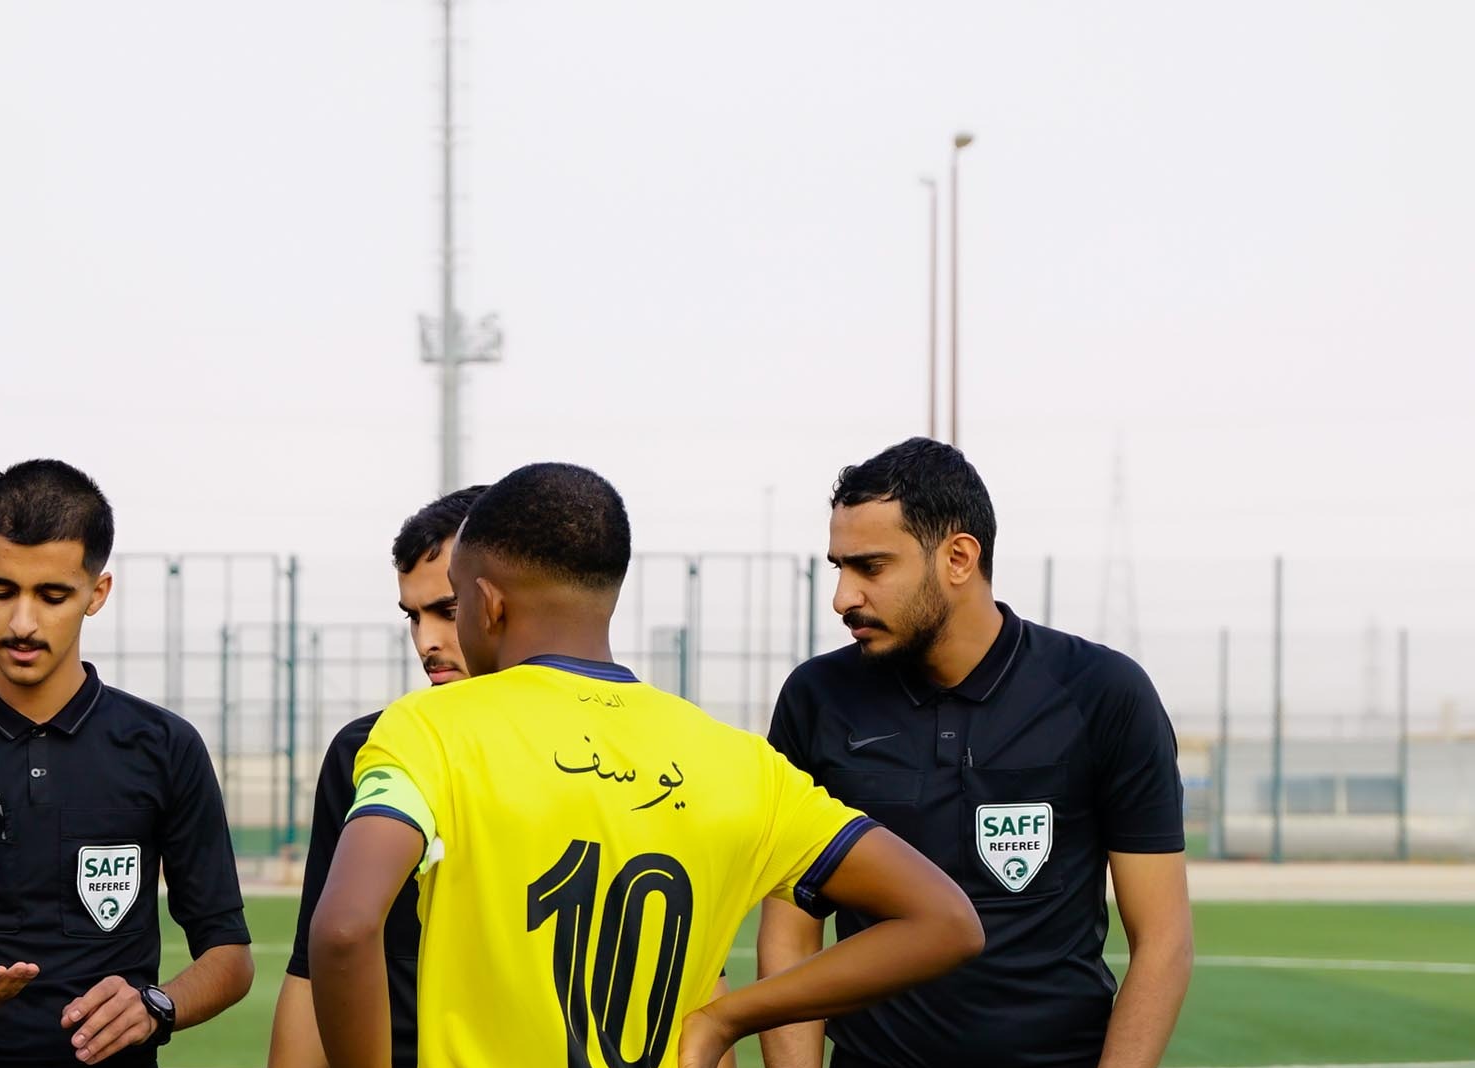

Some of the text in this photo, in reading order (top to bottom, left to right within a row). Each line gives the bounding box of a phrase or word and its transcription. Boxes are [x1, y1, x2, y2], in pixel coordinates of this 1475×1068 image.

[554, 735, 686, 812] يوسف
[983, 815, 1046, 837] SAFF
[989, 841, 1041, 852] REFEREE
[84, 857, 136, 878] SAFF
[88, 882, 131, 892] REFEREE
